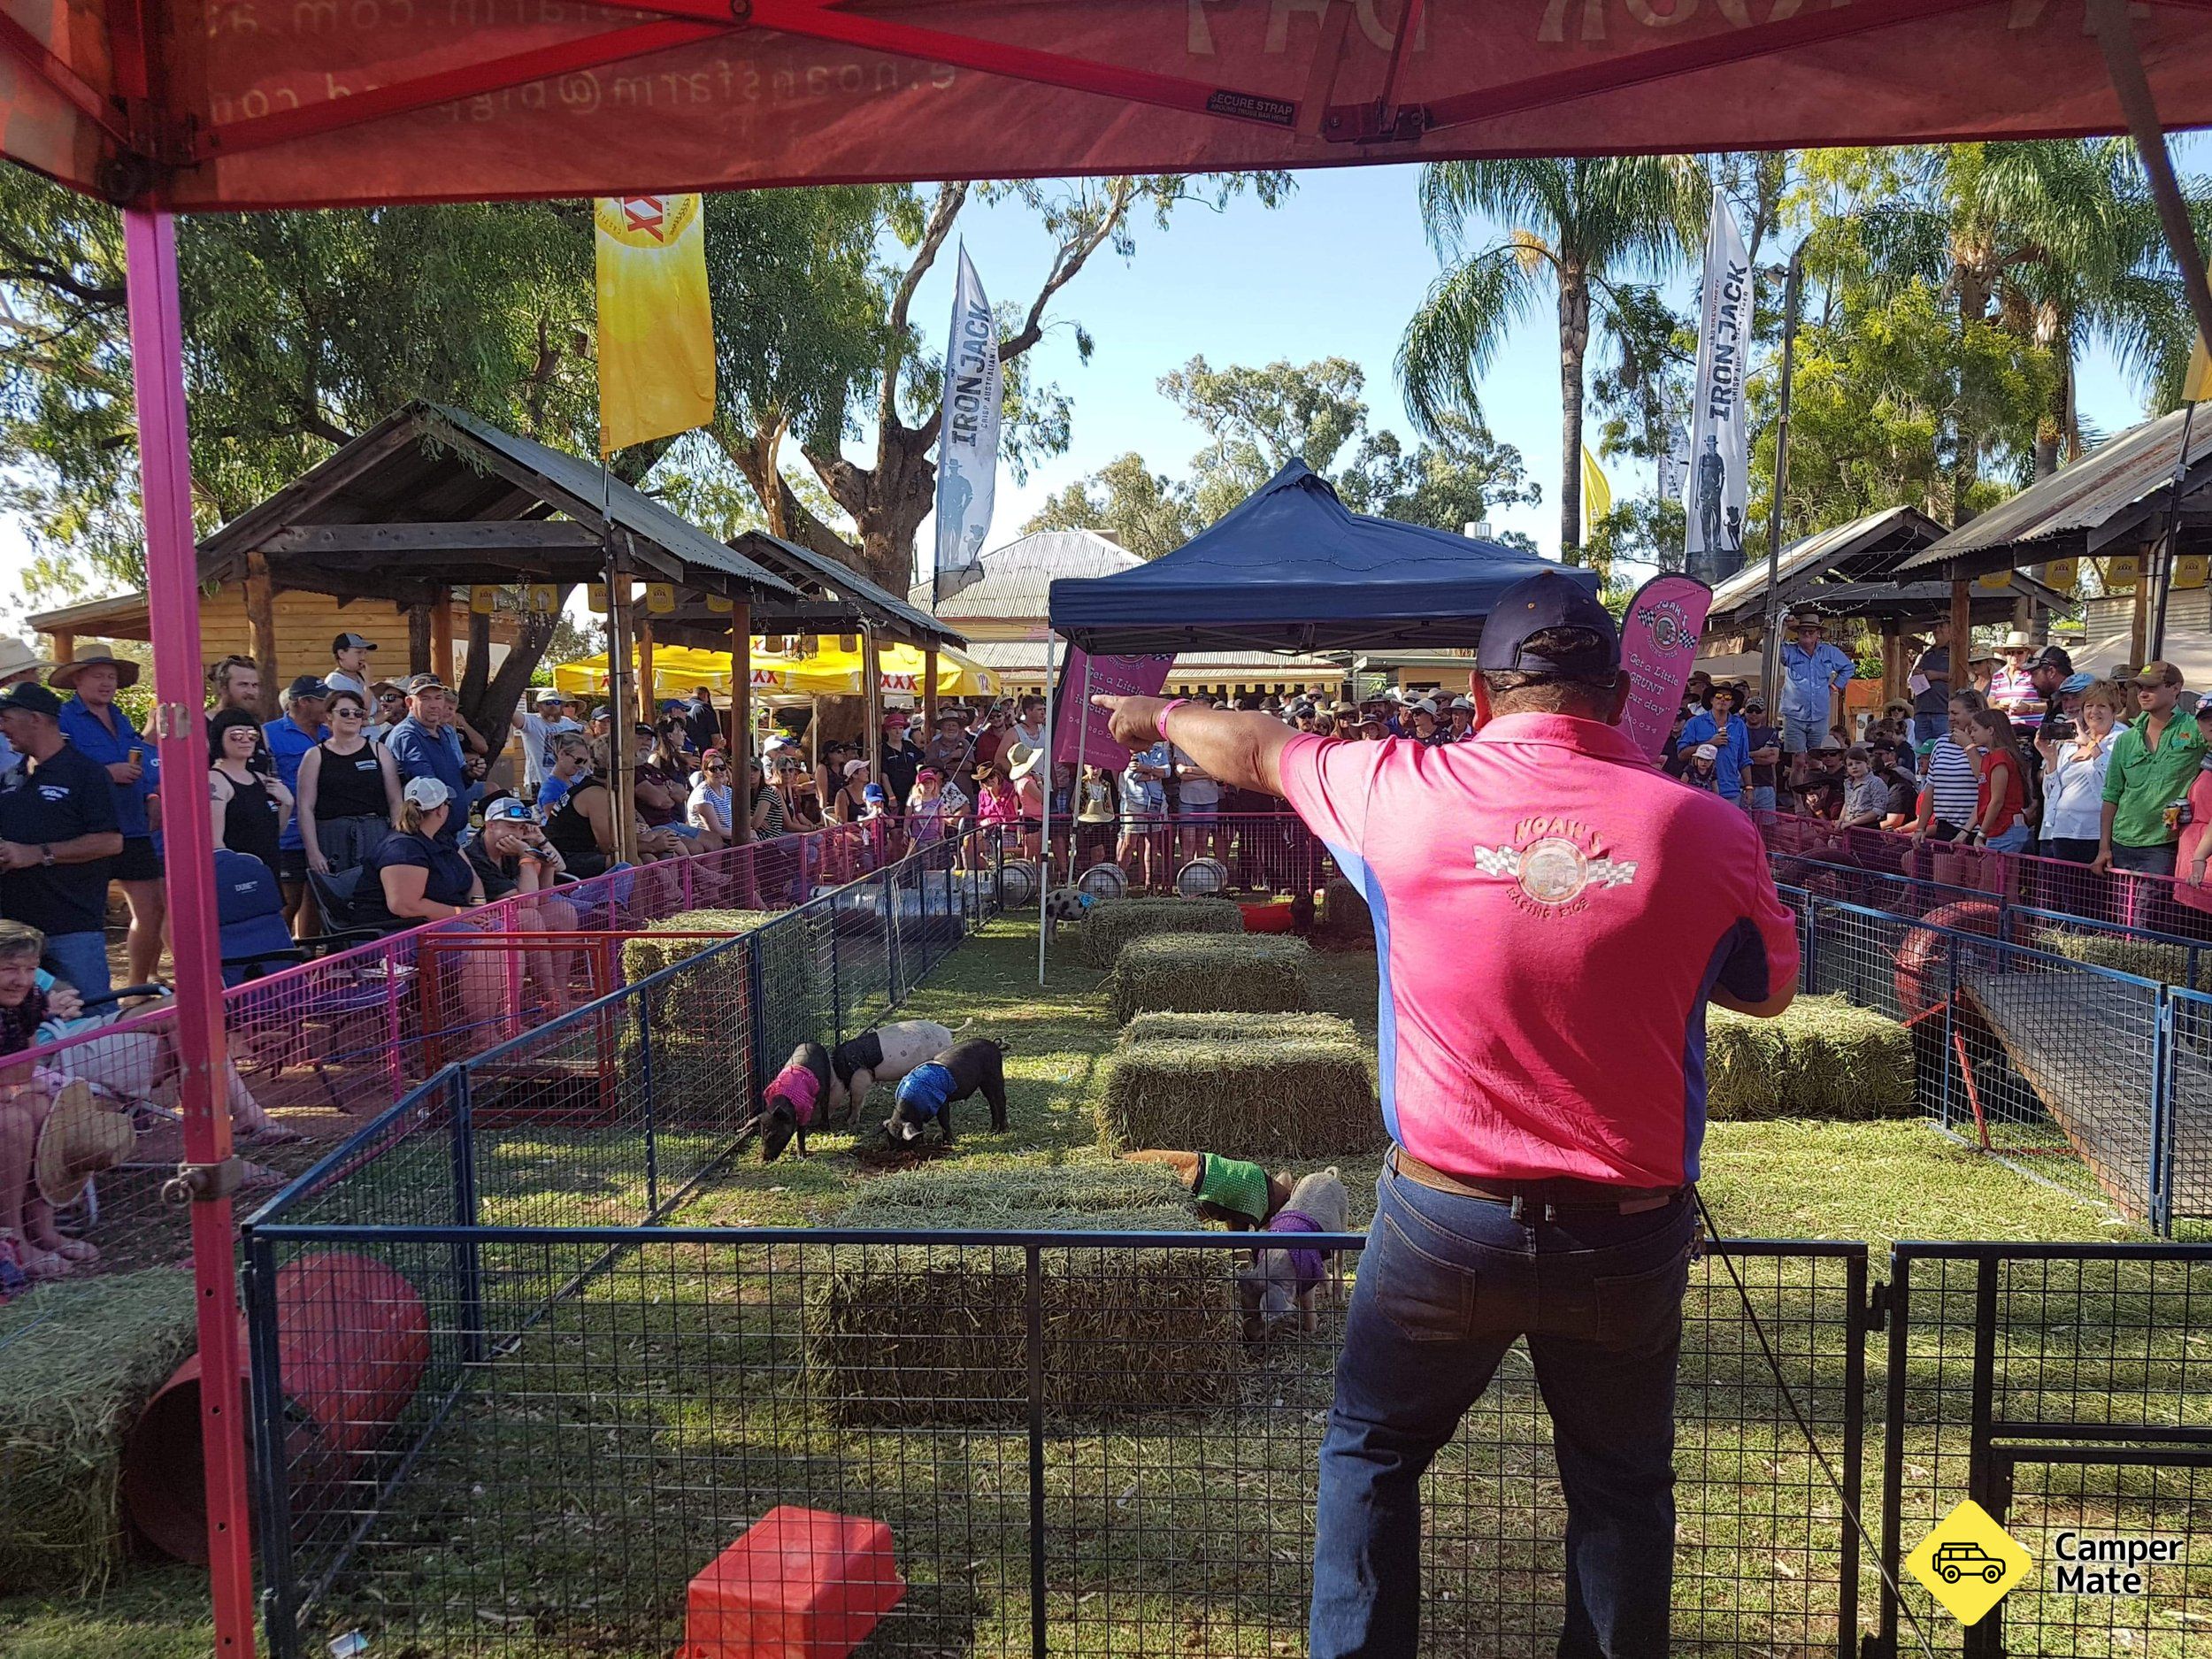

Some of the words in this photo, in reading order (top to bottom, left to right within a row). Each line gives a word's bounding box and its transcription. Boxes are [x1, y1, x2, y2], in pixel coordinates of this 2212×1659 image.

[1210, 93, 1255, 110] SECURE
[1256, 100, 1293, 116] STRAP
[1718, 259, 1748, 342] JACK
[960, 299, 989, 373] JACK
[984, 353, 996, 403] AUSTRALIAN
[1709, 343, 1735, 422] IRON
[951, 374, 982, 448] IRON
[980, 405, 990, 429] CRISP
[1106, 676, 1114, 685] a
[1116, 678, 1145, 695] Little
[1629, 671, 1665, 695] GRUNT
[1653, 665, 1678, 687] Little
